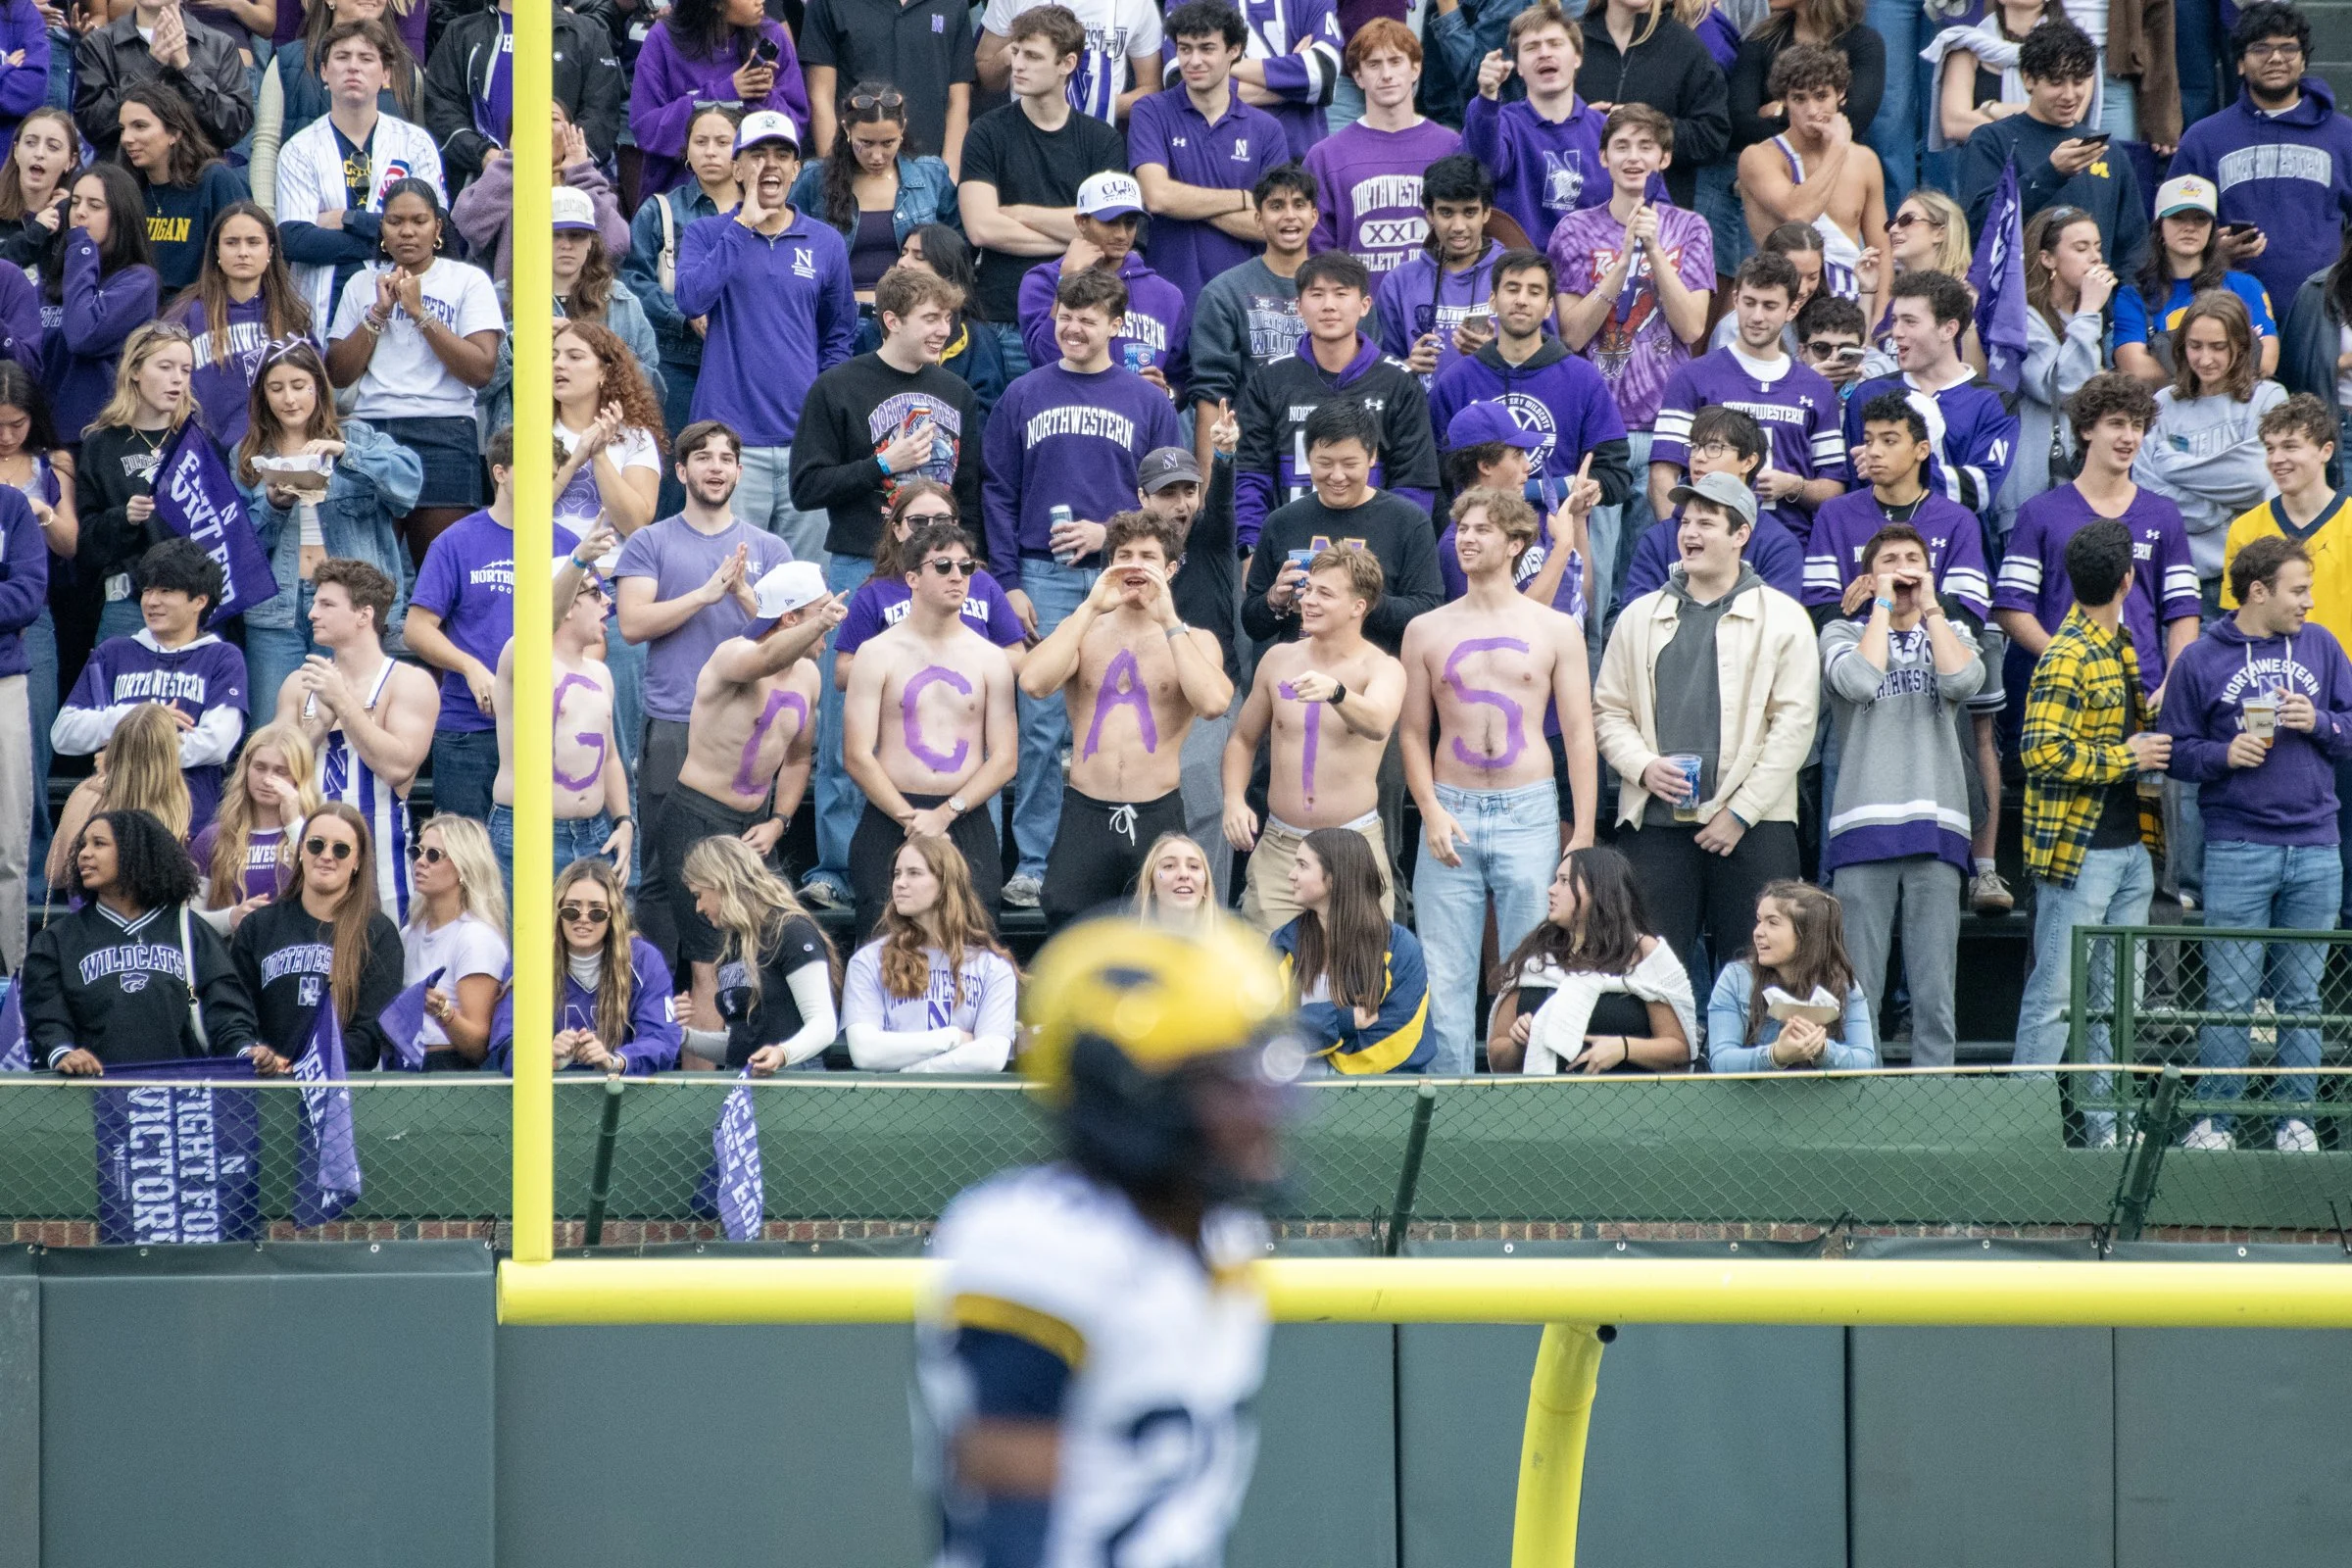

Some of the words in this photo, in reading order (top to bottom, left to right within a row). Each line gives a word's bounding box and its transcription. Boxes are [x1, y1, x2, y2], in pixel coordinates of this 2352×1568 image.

[1234, 139, 1247, 158] N
[1366, 223, 1424, 243] XXL
[794, 247, 813, 269] N
[1026, 406, 1134, 452] NORTHWESTERN
[1161, 453, 1179, 469] N
[1987, 438, 2009, 466] N
[470, 569, 514, 585] NORTH
[2221, 658, 2321, 706] NORTHWESTERN
[904, 665, 973, 774] C
[1083, 648, 1158, 764] A
[1445, 636, 1530, 769] S
[322, 749, 349, 795] N
[79, 946, 186, 986] WILDCATS
[928, 1001, 951, 1032] N
[220, 1156, 245, 1175] N
